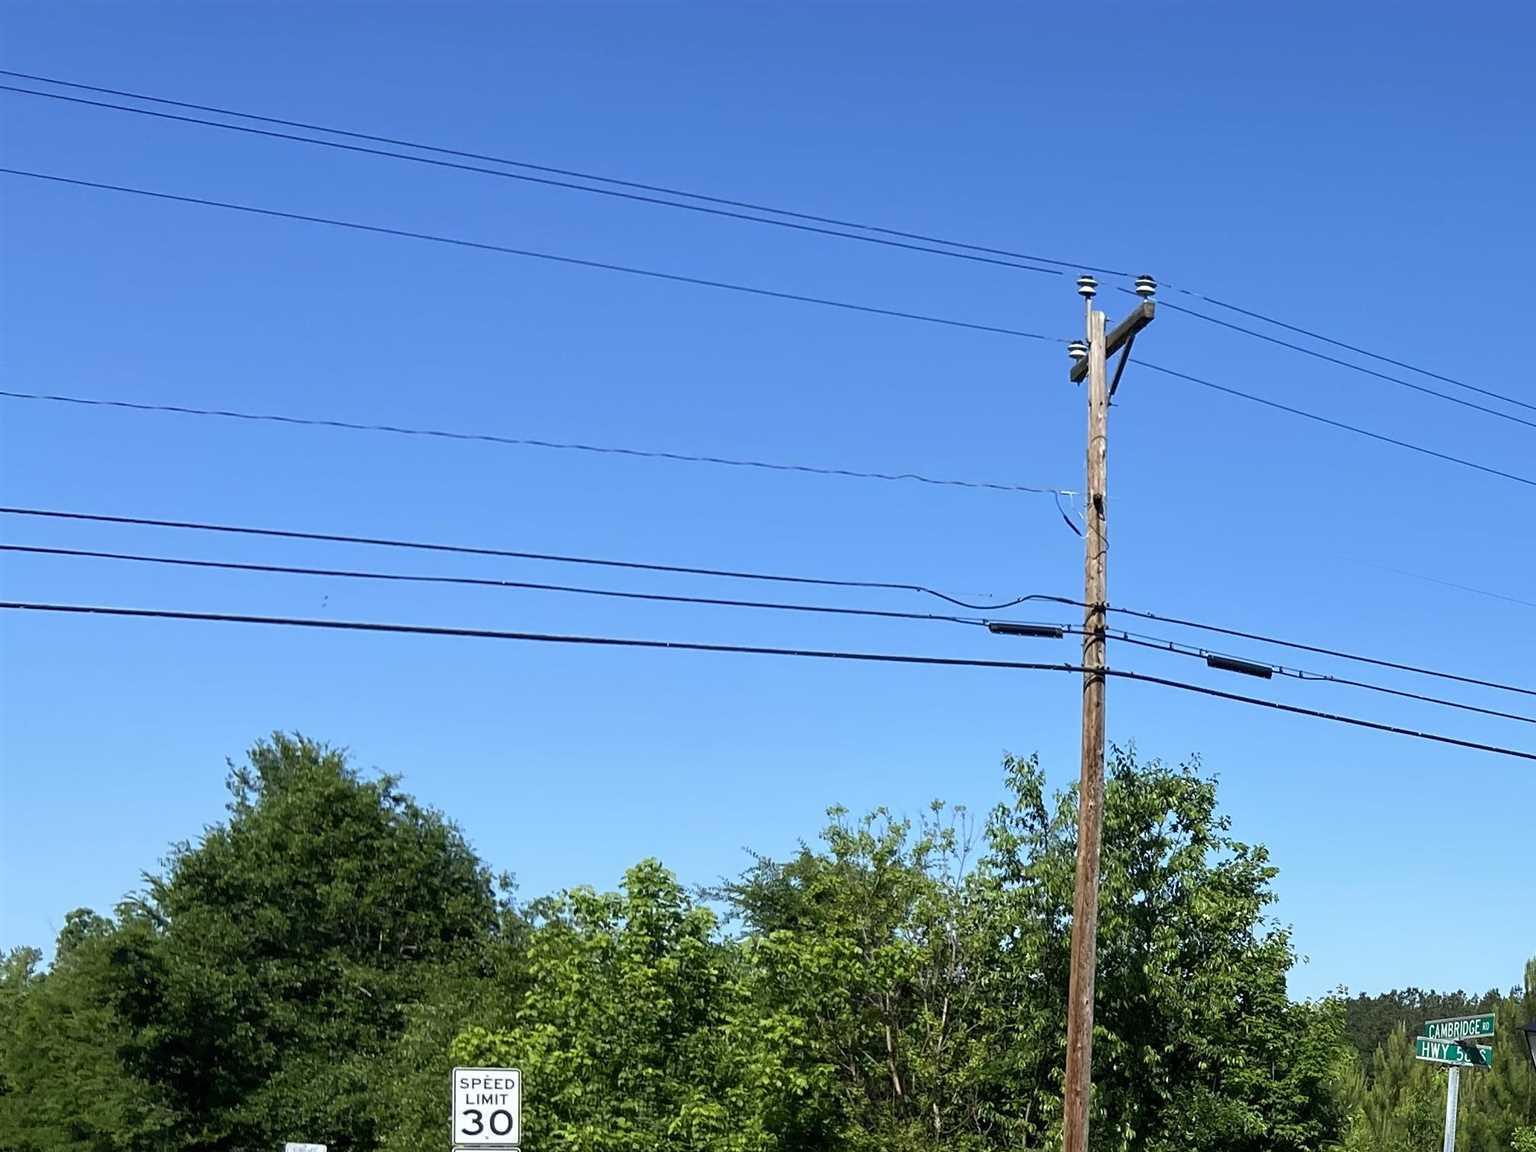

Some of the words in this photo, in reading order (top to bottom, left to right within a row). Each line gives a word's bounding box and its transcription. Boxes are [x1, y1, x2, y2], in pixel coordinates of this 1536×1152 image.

[1428, 1019, 1481, 1039] CAMBRIDGE
[1482, 1021, 1490, 1031] RD
[1422, 1041, 1450, 1060] HWY
[460, 1078, 515, 1090] SPEED
[465, 1093, 509, 1105] LIMIT
[461, 1109, 514, 1136] 30
